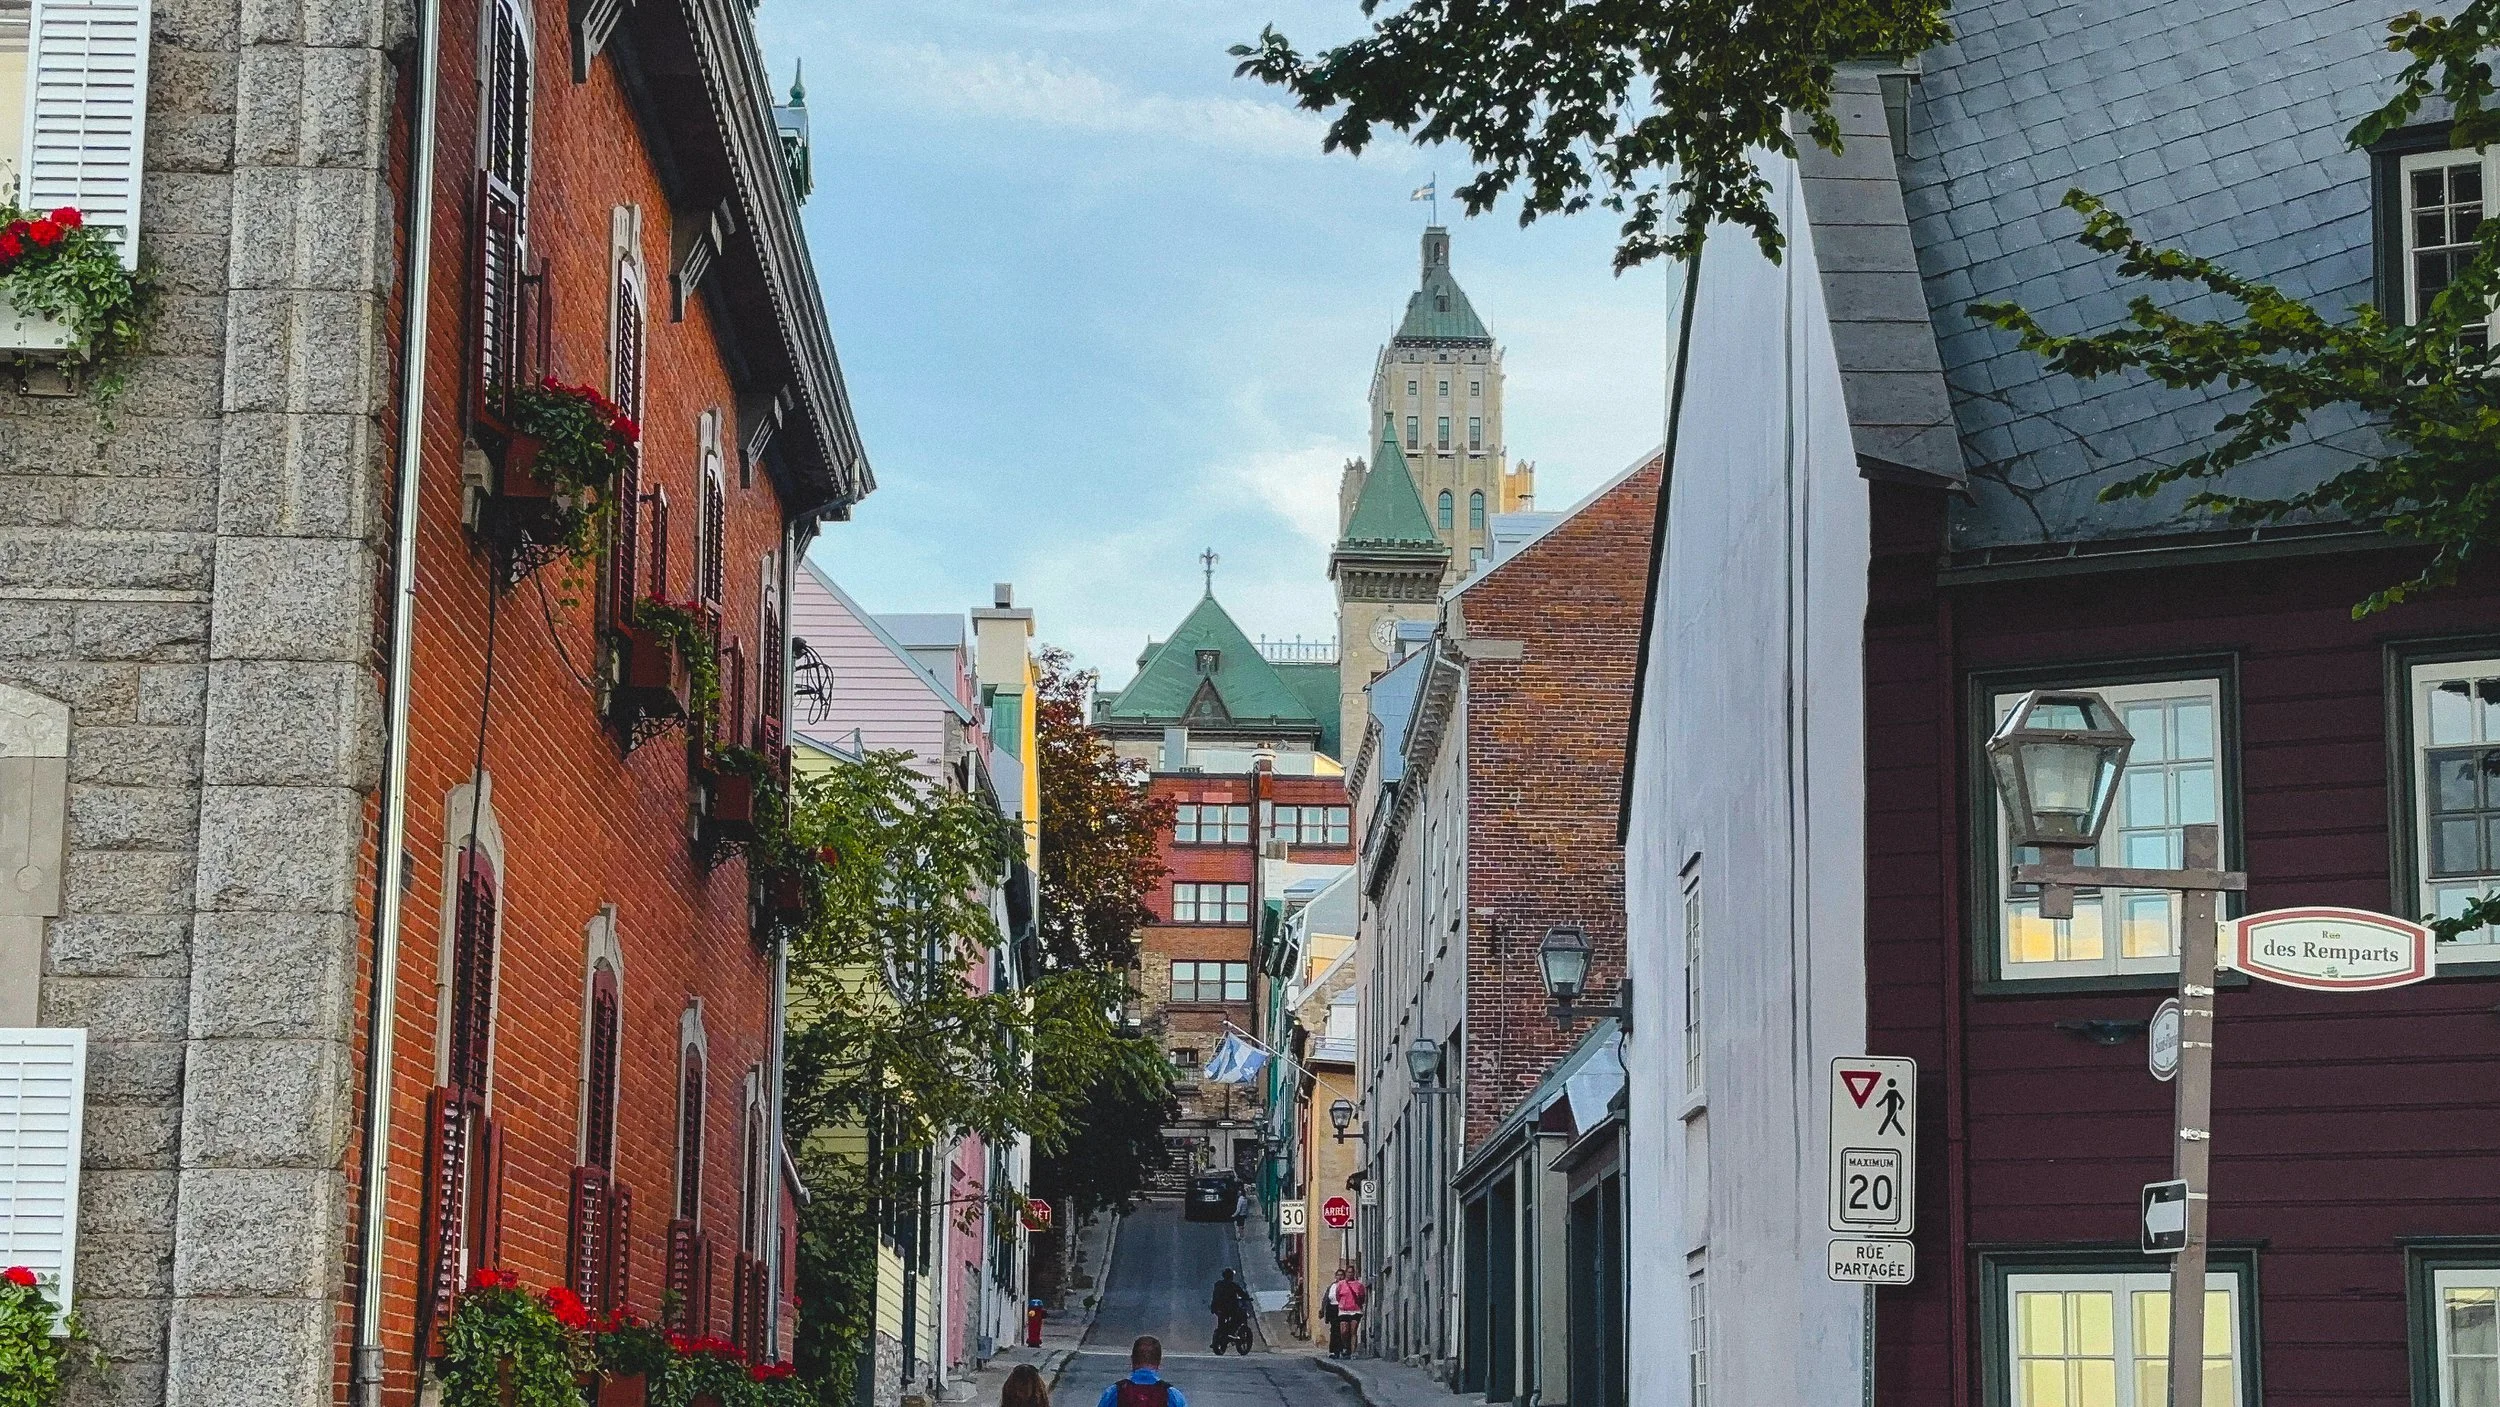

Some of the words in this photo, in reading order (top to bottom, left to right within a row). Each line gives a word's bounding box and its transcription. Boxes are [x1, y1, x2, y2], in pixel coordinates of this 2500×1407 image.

[2322, 930, 2341, 940] Rue
[2263, 939, 2297, 957] des
[2303, 941, 2399, 965] Remparts
[1848, 1158, 1894, 1168] MAXIMUM
[1849, 1174, 1893, 1211] 20
[1283, 1209, 1304, 1226] 30
[1834, 1261, 1906, 1277] PARTAGÉE
